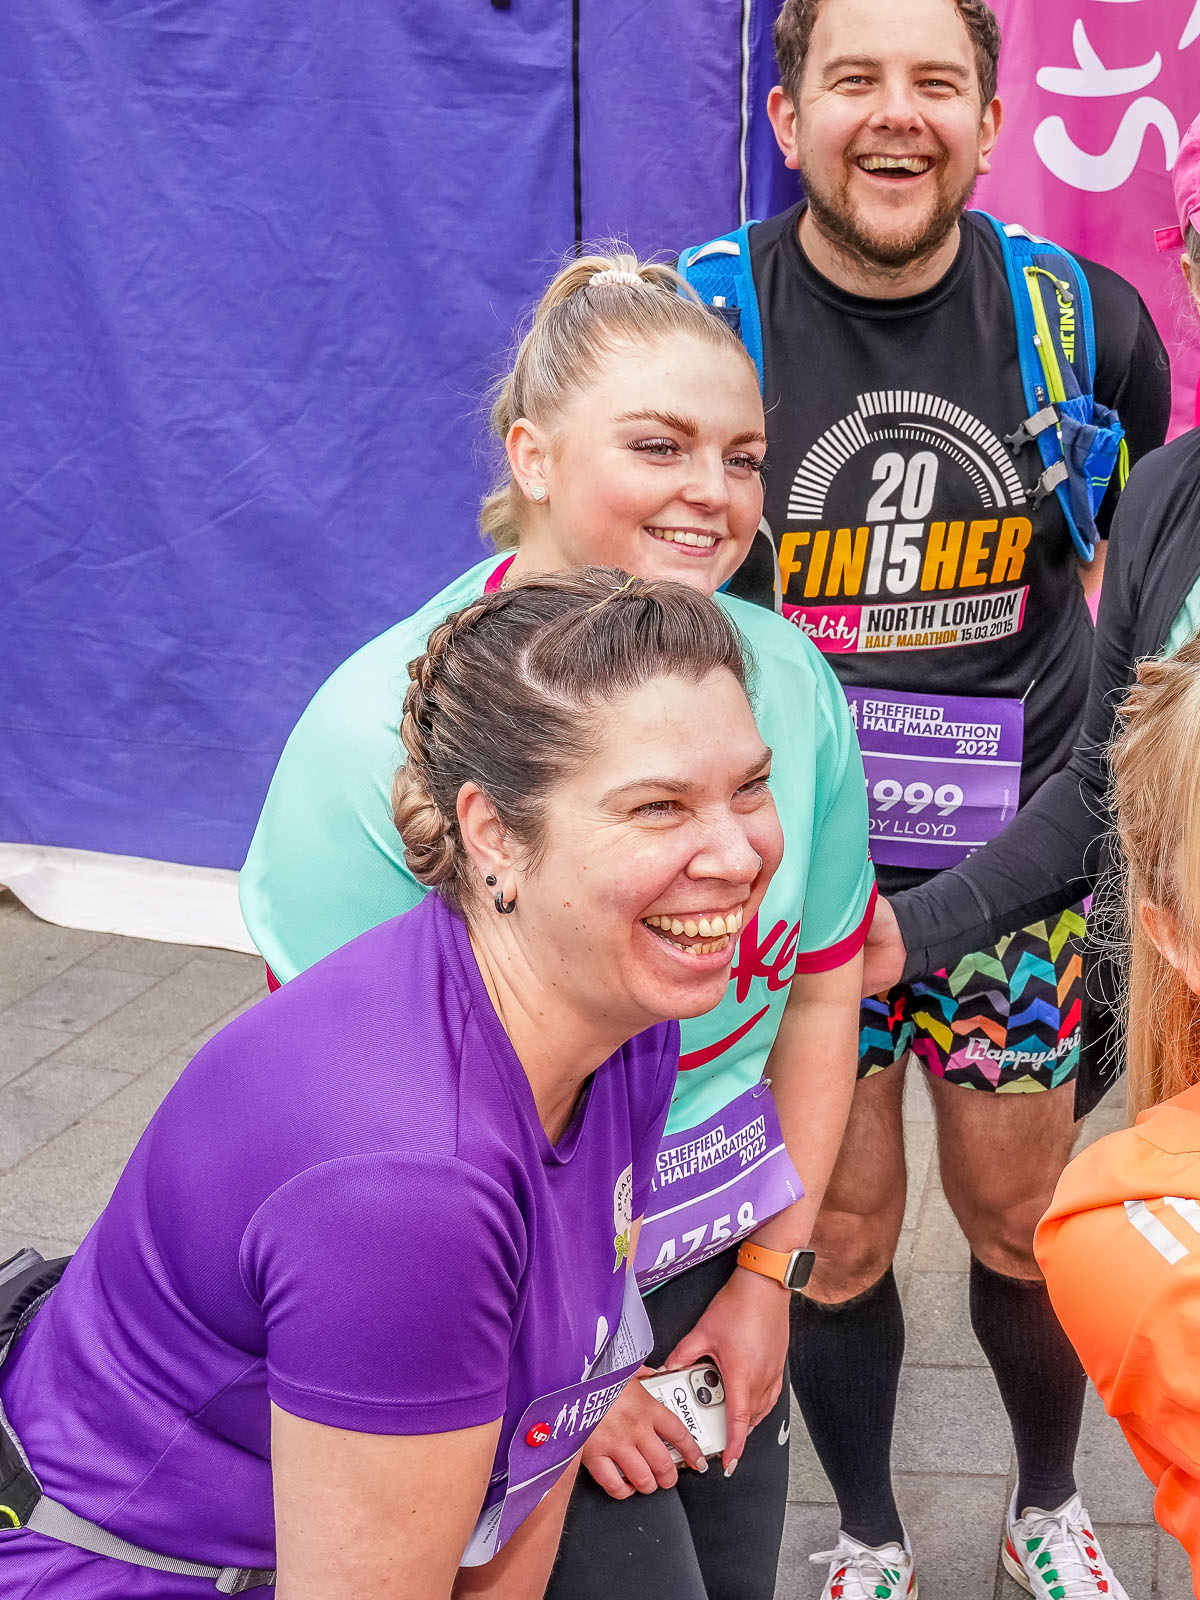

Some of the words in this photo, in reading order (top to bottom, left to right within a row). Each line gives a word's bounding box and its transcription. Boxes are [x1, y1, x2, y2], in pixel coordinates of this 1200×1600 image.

[866, 451, 939, 522] 20
[867, 605, 936, 632] NORTH
[941, 594, 1017, 627] LONDON
[865, 635, 893, 648] HALF
[896, 630, 957, 647] MARATHON
[961, 619, 1013, 641] 15.03.2015
[863, 716, 904, 732] HALF
[906, 722, 999, 739] MARATHON
[864, 702, 941, 721] SHEFFIELD
[955, 740, 998, 756] 2022
[865, 779, 964, 816] 999
[893, 820, 957, 837] LLOYD
[658, 1128, 723, 1170] SHEFFIELD
[661, 1159, 698, 1187] HALF
[701, 1117, 764, 1170] MARATHON
[740, 1135, 767, 1167] 2022
[647, 1201, 759, 1273] 4758
